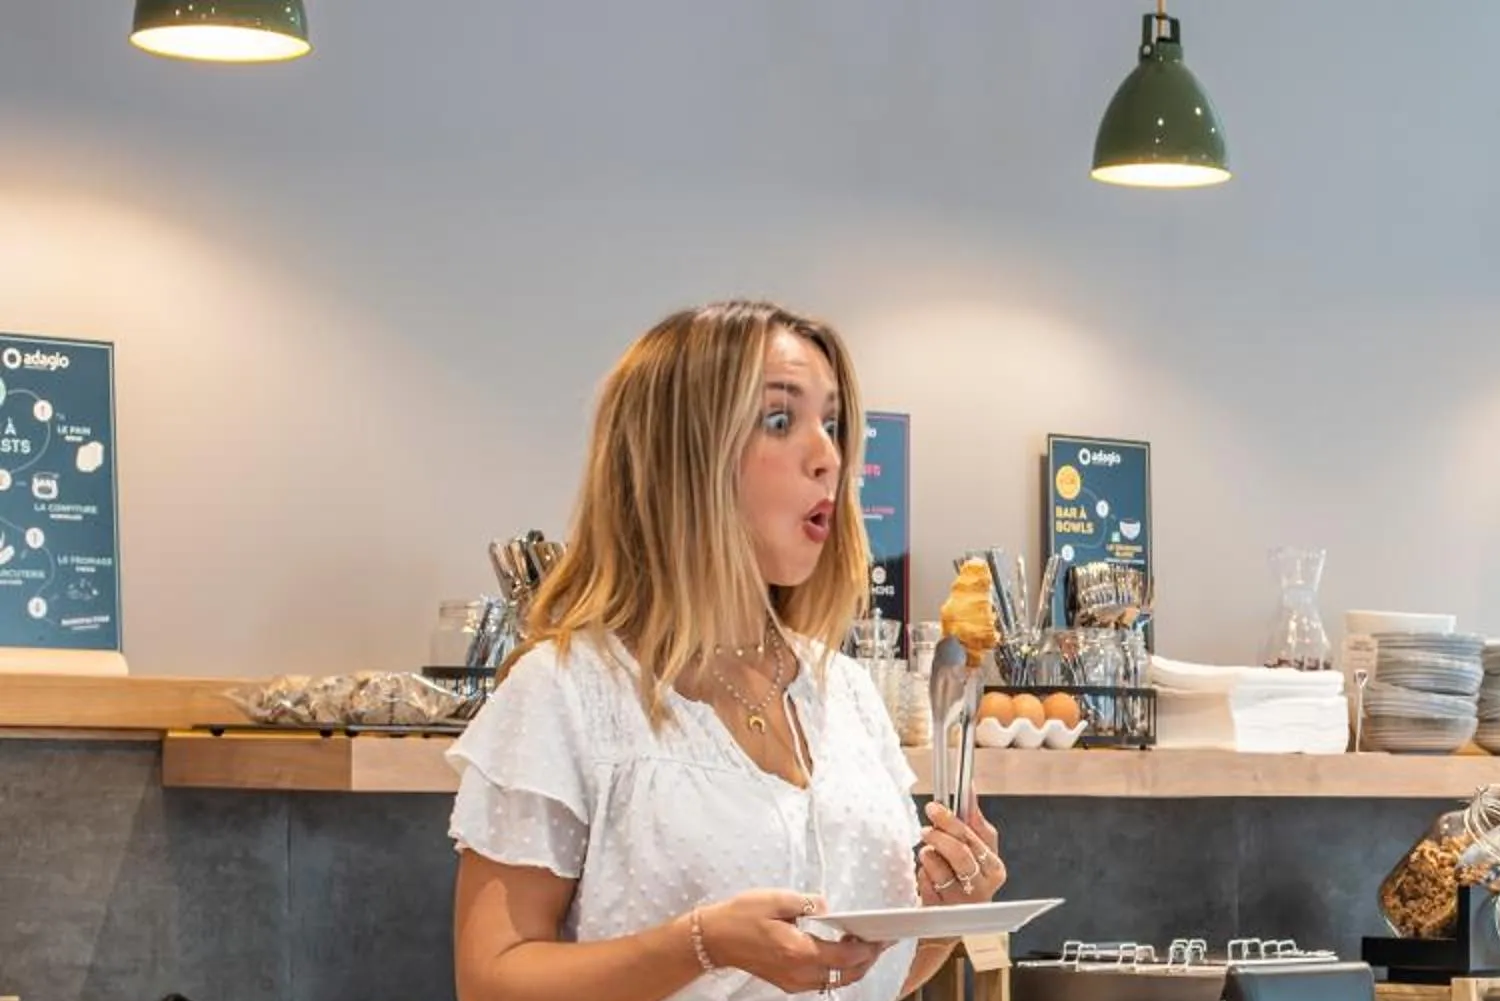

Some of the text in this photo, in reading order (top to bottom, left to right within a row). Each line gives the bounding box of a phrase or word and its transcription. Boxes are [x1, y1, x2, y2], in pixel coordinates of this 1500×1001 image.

[23, 349, 70, 371] adagio
[4, 416, 17, 436] À
[1055, 504, 1088, 520] BAR À
[1055, 520, 1095, 535] BOWLS
